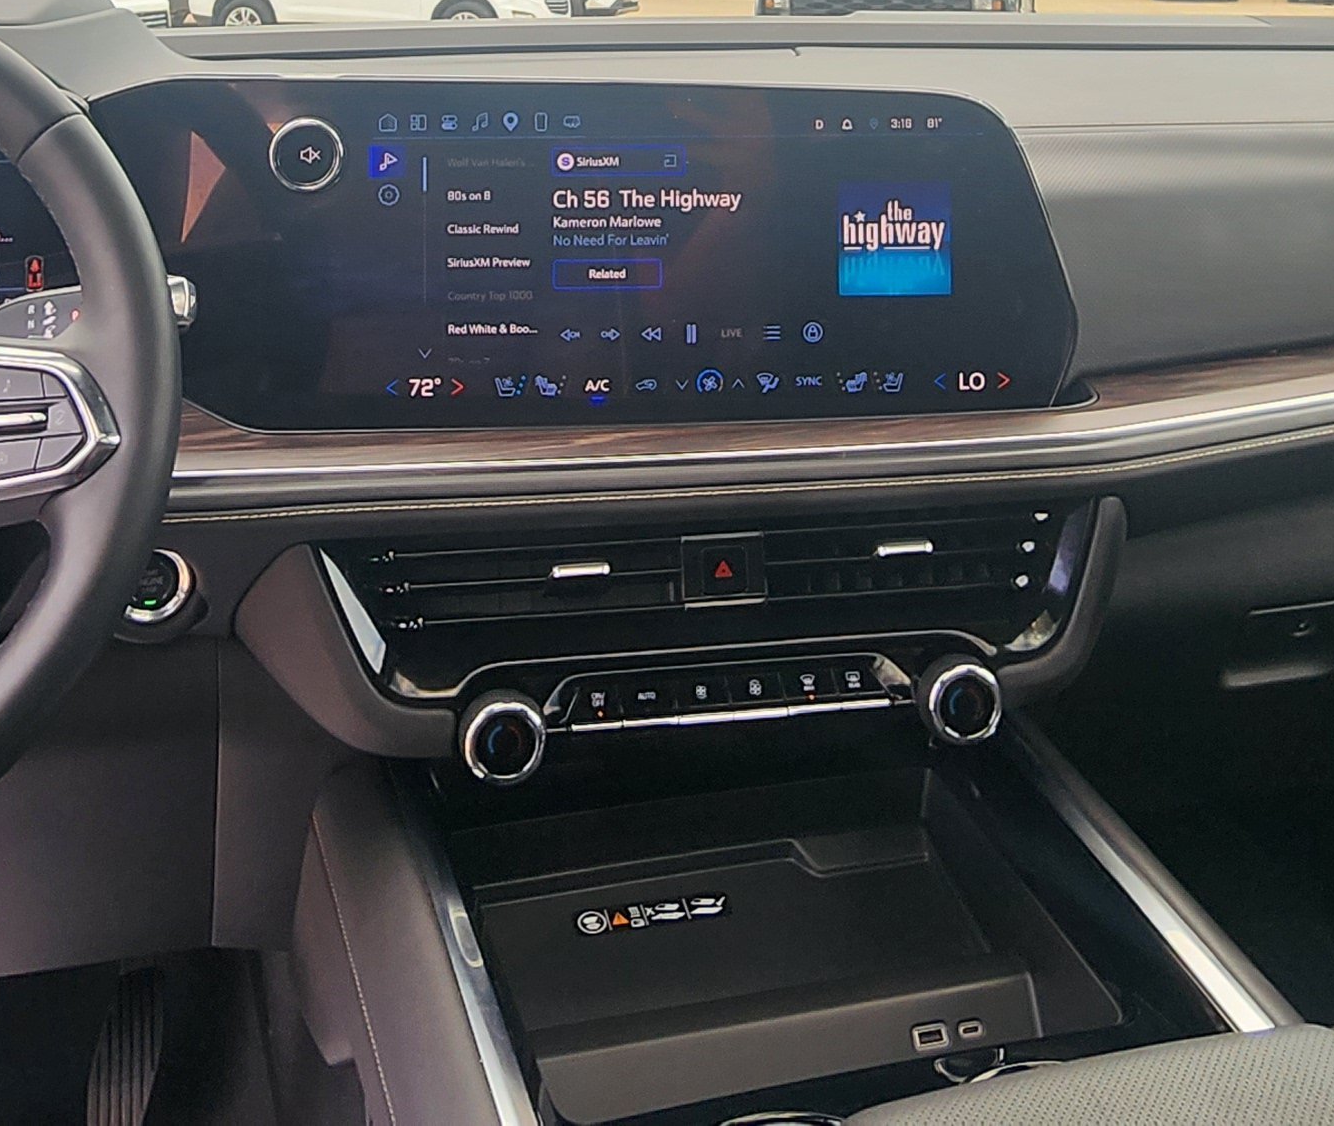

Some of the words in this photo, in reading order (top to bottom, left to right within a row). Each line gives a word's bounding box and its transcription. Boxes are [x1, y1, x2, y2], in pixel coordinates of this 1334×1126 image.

[890, 118, 912, 129] 3:16
[577, 157, 620, 167] SiriusXM
[447, 190, 467, 201] 80s
[469, 192, 483, 201] on
[484, 190, 491, 201] 8
[553, 190, 578, 208] Ch
[583, 190, 610, 208] 56
[619, 189, 655, 208] The
[661, 188, 742, 212] Highway
[887, 200, 913, 222] the
[553, 216, 607, 228] Kameron
[609, 215, 662, 228] Marlowe
[447, 224, 481, 235] Classic
[483, 223, 519, 235] Rewind
[843, 213, 945, 251] highway
[553, 234, 571, 246] No
[573, 233, 605, 245] Need
[607, 233, 627, 245] For
[630, 232, 669, 245] Leavin'
[447, 258, 490, 269] SiriusXM
[492, 257, 531, 269] Preview
[587, 267, 627, 280] Related
[448, 290, 487, 302] Country
[489, 289, 507, 302] Top
[509, 288, 534, 300] 1000
[448, 324, 467, 335] Red
[468, 324, 497, 334] White
[499, 323, 507, 334] &
[721, 327, 743, 339] LIVE
[585, 378, 610, 394] A/C
[795, 375, 822, 388] SYNC
[958, 372, 986, 392] LO
[637, 691, 657, 701] AUTO
